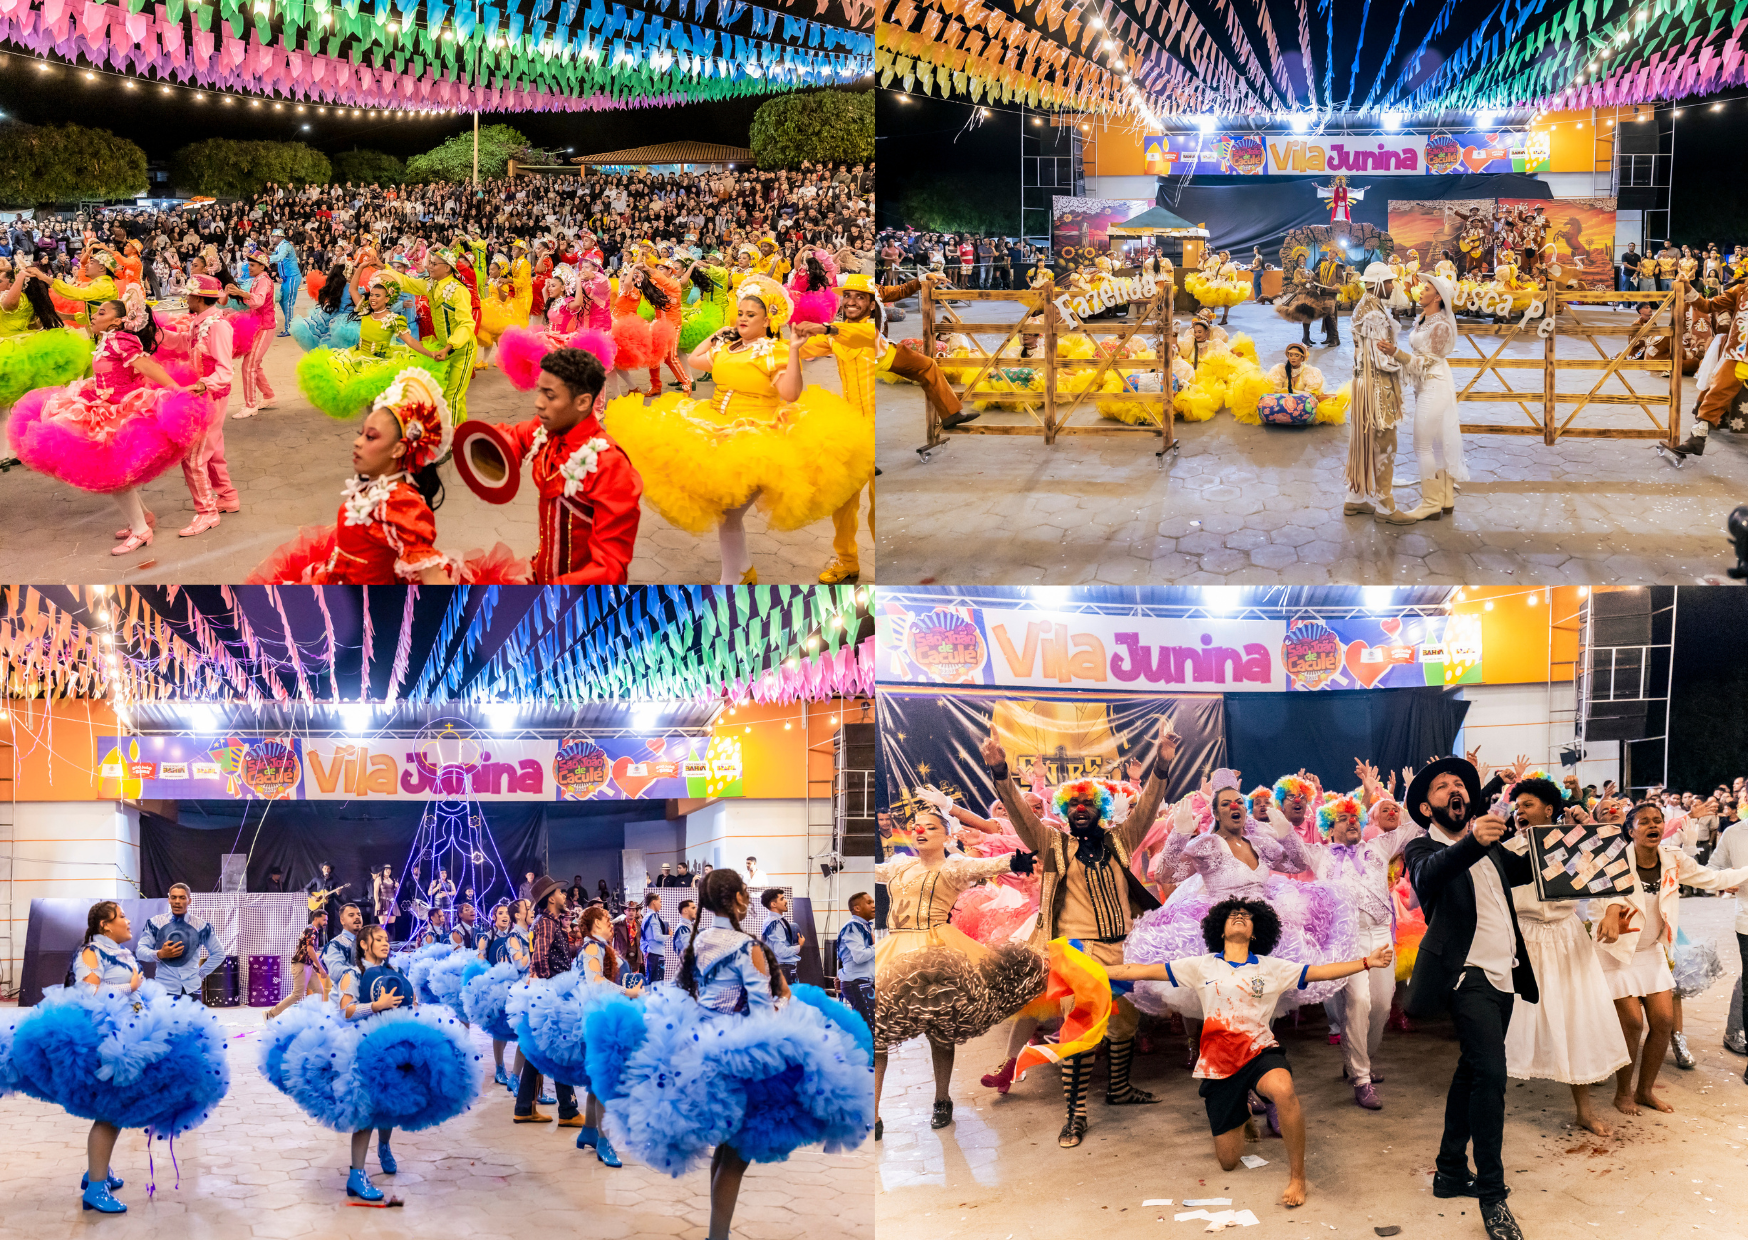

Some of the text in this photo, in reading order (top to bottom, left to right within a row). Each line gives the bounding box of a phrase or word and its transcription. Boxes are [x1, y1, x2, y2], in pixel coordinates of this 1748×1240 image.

[1269, 140, 1418, 173] Vila Junina
[1428, 152, 1457, 164] Caculé
[1052, 275, 1156, 330] Fazenda
[914, 629, 976, 648] São João
[938, 641, 953, 652] de
[916, 645, 978, 664] Caculé
[991, 620, 1271, 685] Vila Junina
[1287, 640, 1336, 657] São João
[1305, 650, 1317, 661] de
[1287, 652, 1336, 673] Caculé
[247, 757, 294, 771] São João
[264, 765, 276, 774] de
[307, 744, 544, 797] Vila Junina
[559, 756, 604, 771] São João
[575, 765, 586, 774] de
[247, 768, 294, 784] Caculé
[558, 767, 604, 784] Caculé
